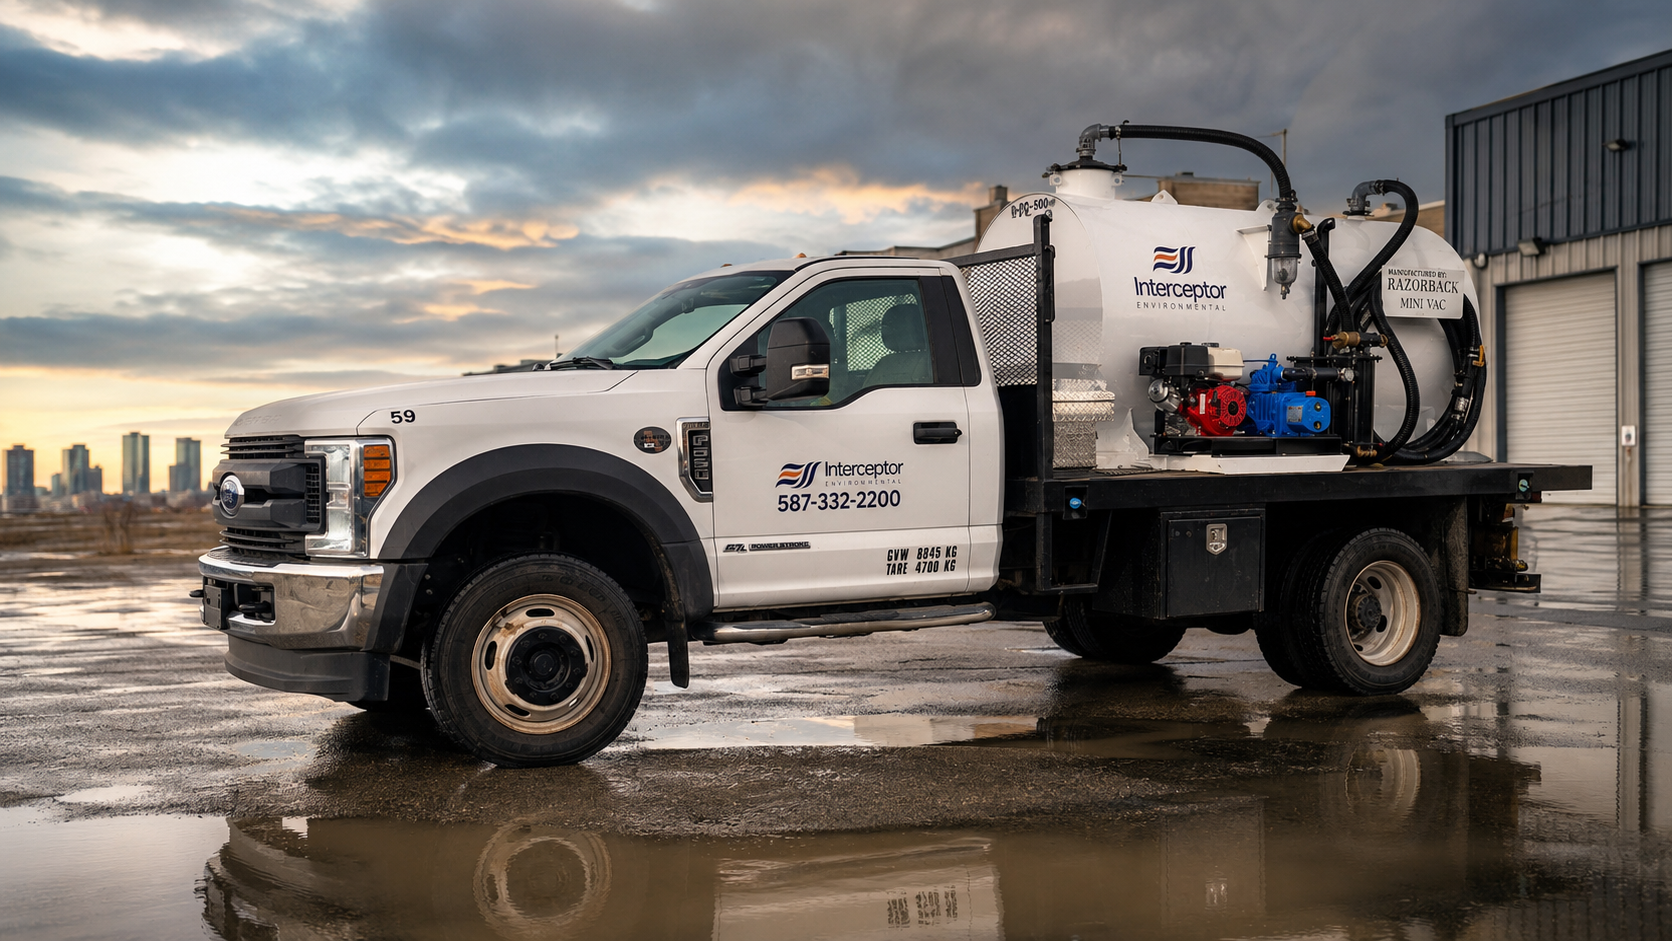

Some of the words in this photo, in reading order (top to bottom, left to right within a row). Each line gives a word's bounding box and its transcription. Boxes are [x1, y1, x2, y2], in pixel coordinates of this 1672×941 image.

[1388, 268, 1436, 278] MANUFACTURED
[1133, 276, 1227, 303] Interceptor
[1387, 277, 1460, 294] RAZORBACK
[1136, 301, 1226, 312] ENVIRONMENTAL
[1400, 297, 1424, 310] MINI
[1426, 298, 1447, 311] VAC
[390, 409, 416, 424] 59
[825, 459, 904, 479] Interceptor
[777, 489, 901, 512] 587-332-2200
[887, 548, 910, 562] GVW
[916, 546, 942, 560] 8845
[945, 545, 958, 559] KG
[886, 562, 908, 576] TARE
[914, 560, 940, 574] 4700
[943, 559, 957, 573] KG
